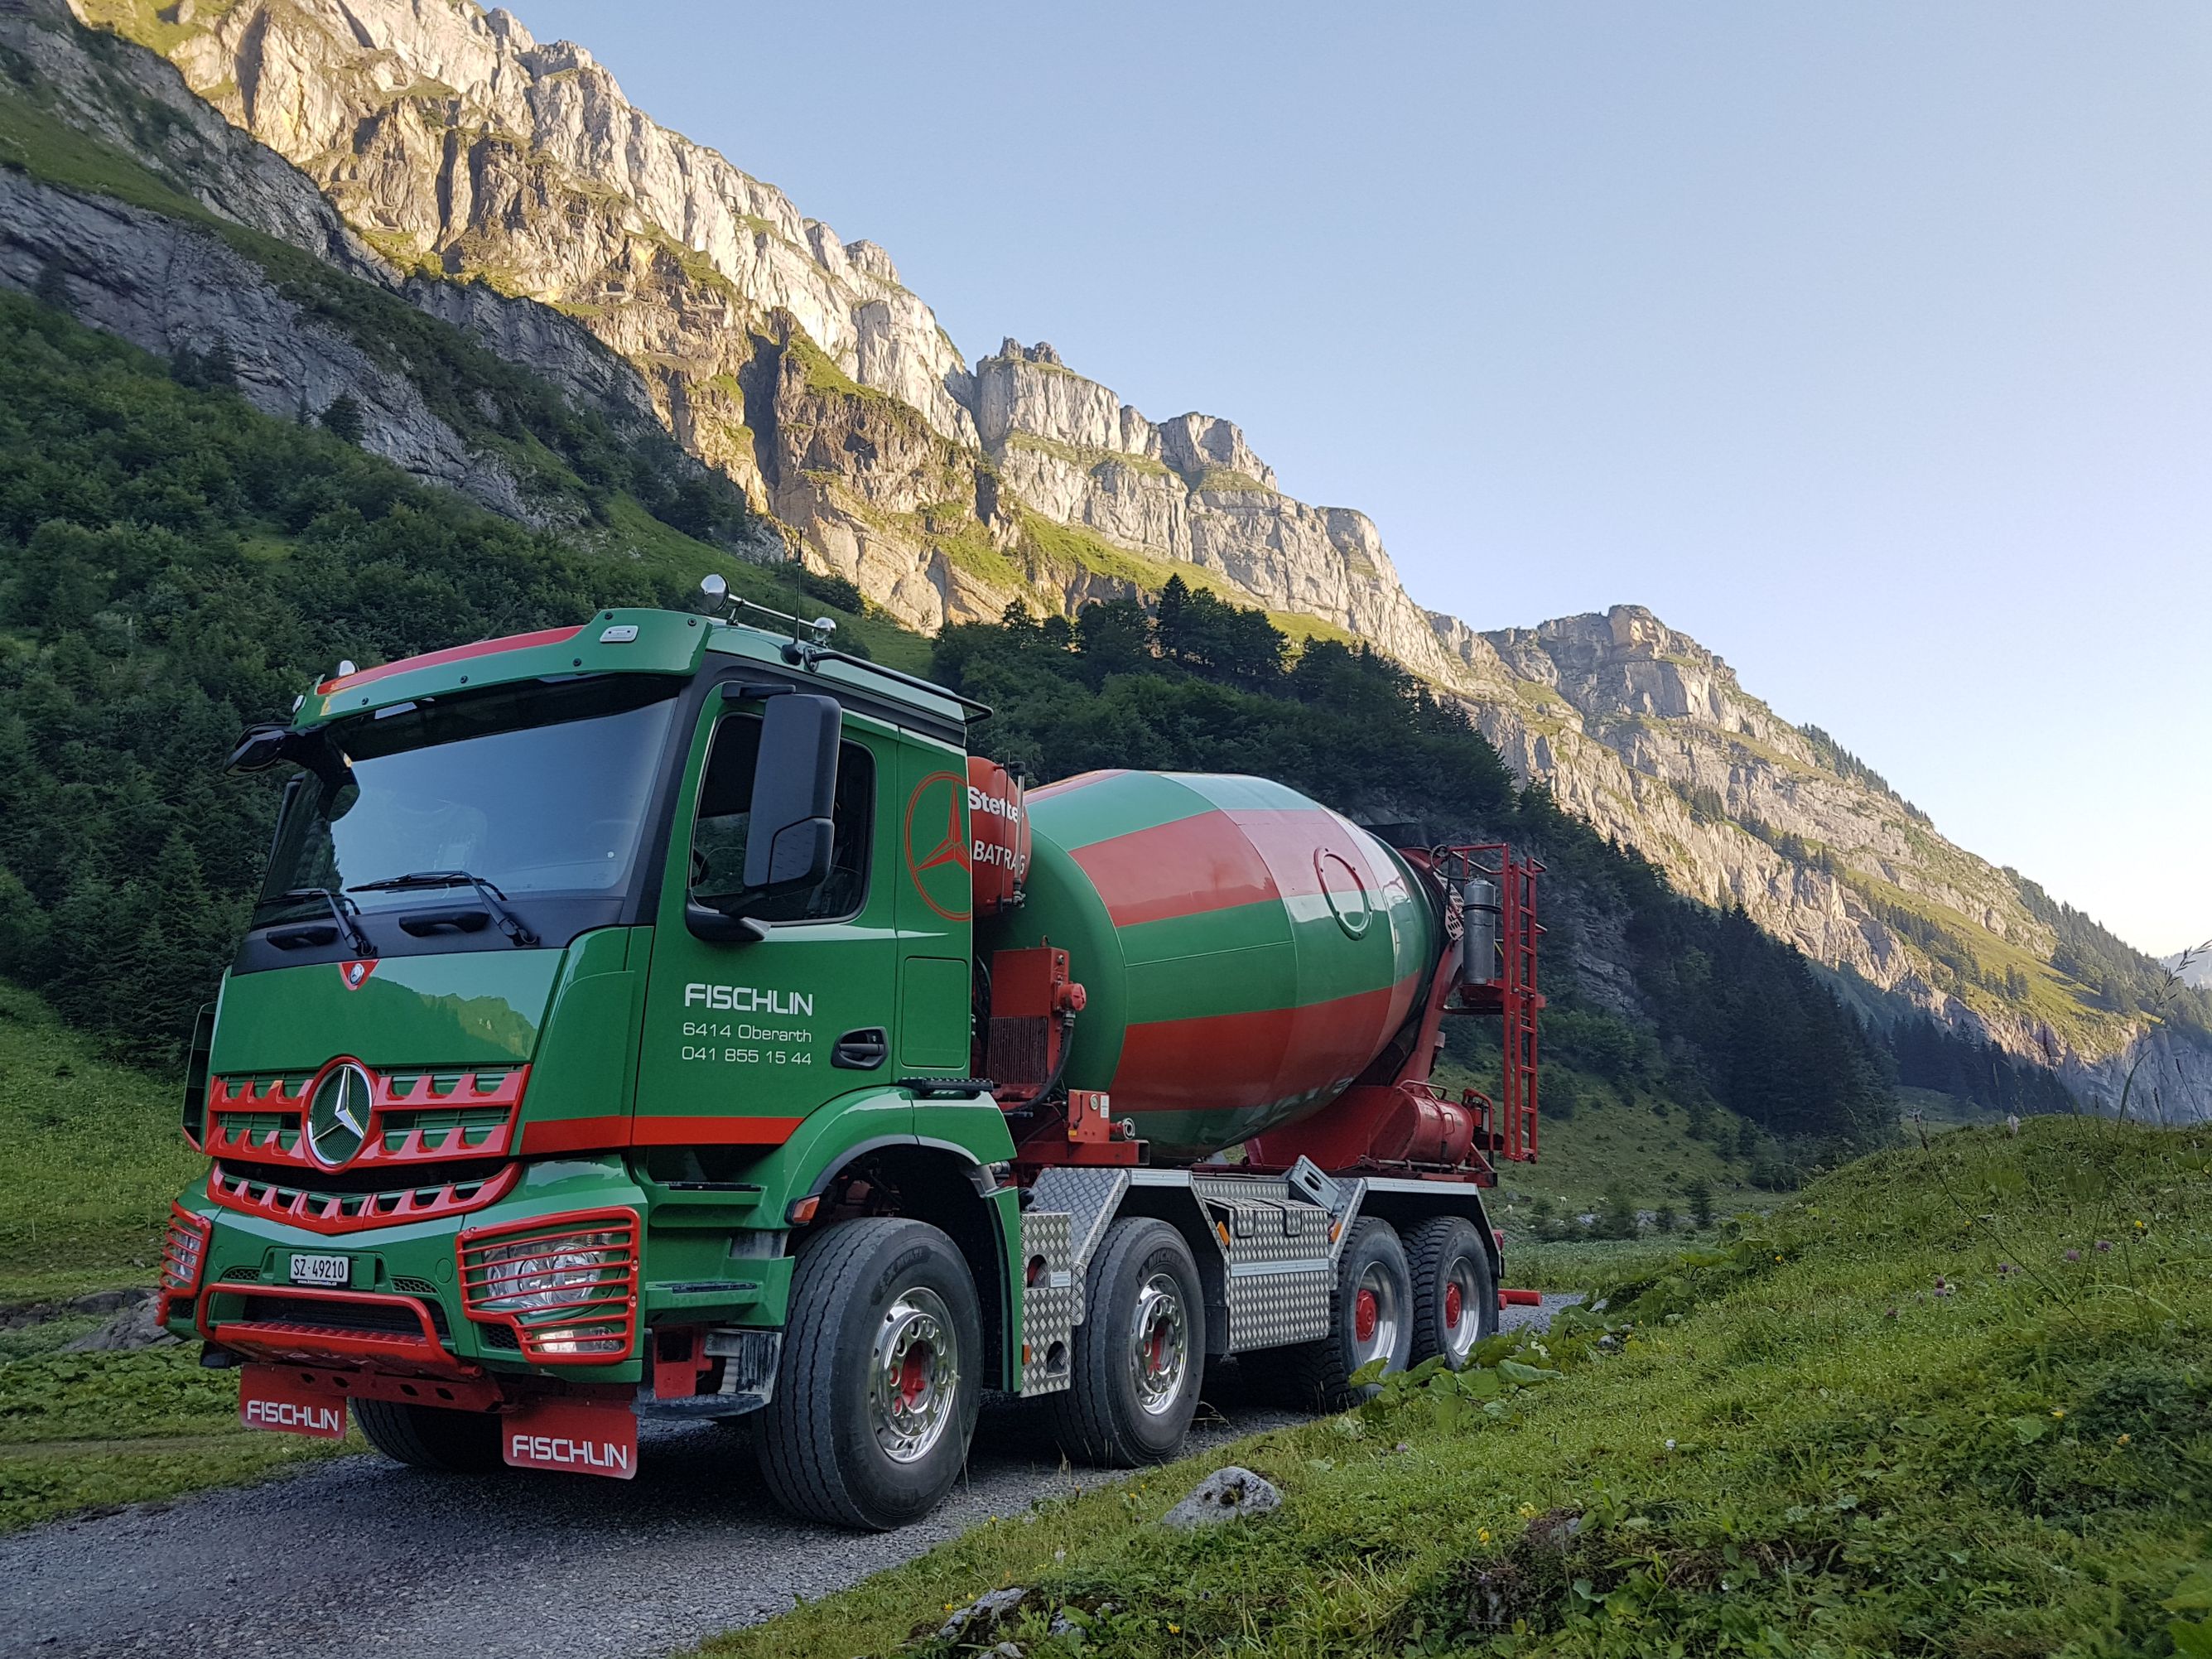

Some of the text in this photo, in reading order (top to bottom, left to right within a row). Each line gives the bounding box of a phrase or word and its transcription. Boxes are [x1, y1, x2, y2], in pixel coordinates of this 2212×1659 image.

[968, 786, 1024, 823] Stette
[684, 982, 813, 1016] FISCHLIN
[682, 1022, 812, 1043] 6414 Oberarth
[682, 1046, 812, 1065] 041 855 15 44
[247, 1400, 339, 1432] FISCHLIN
[512, 1435, 628, 1470] FISCHLIN
